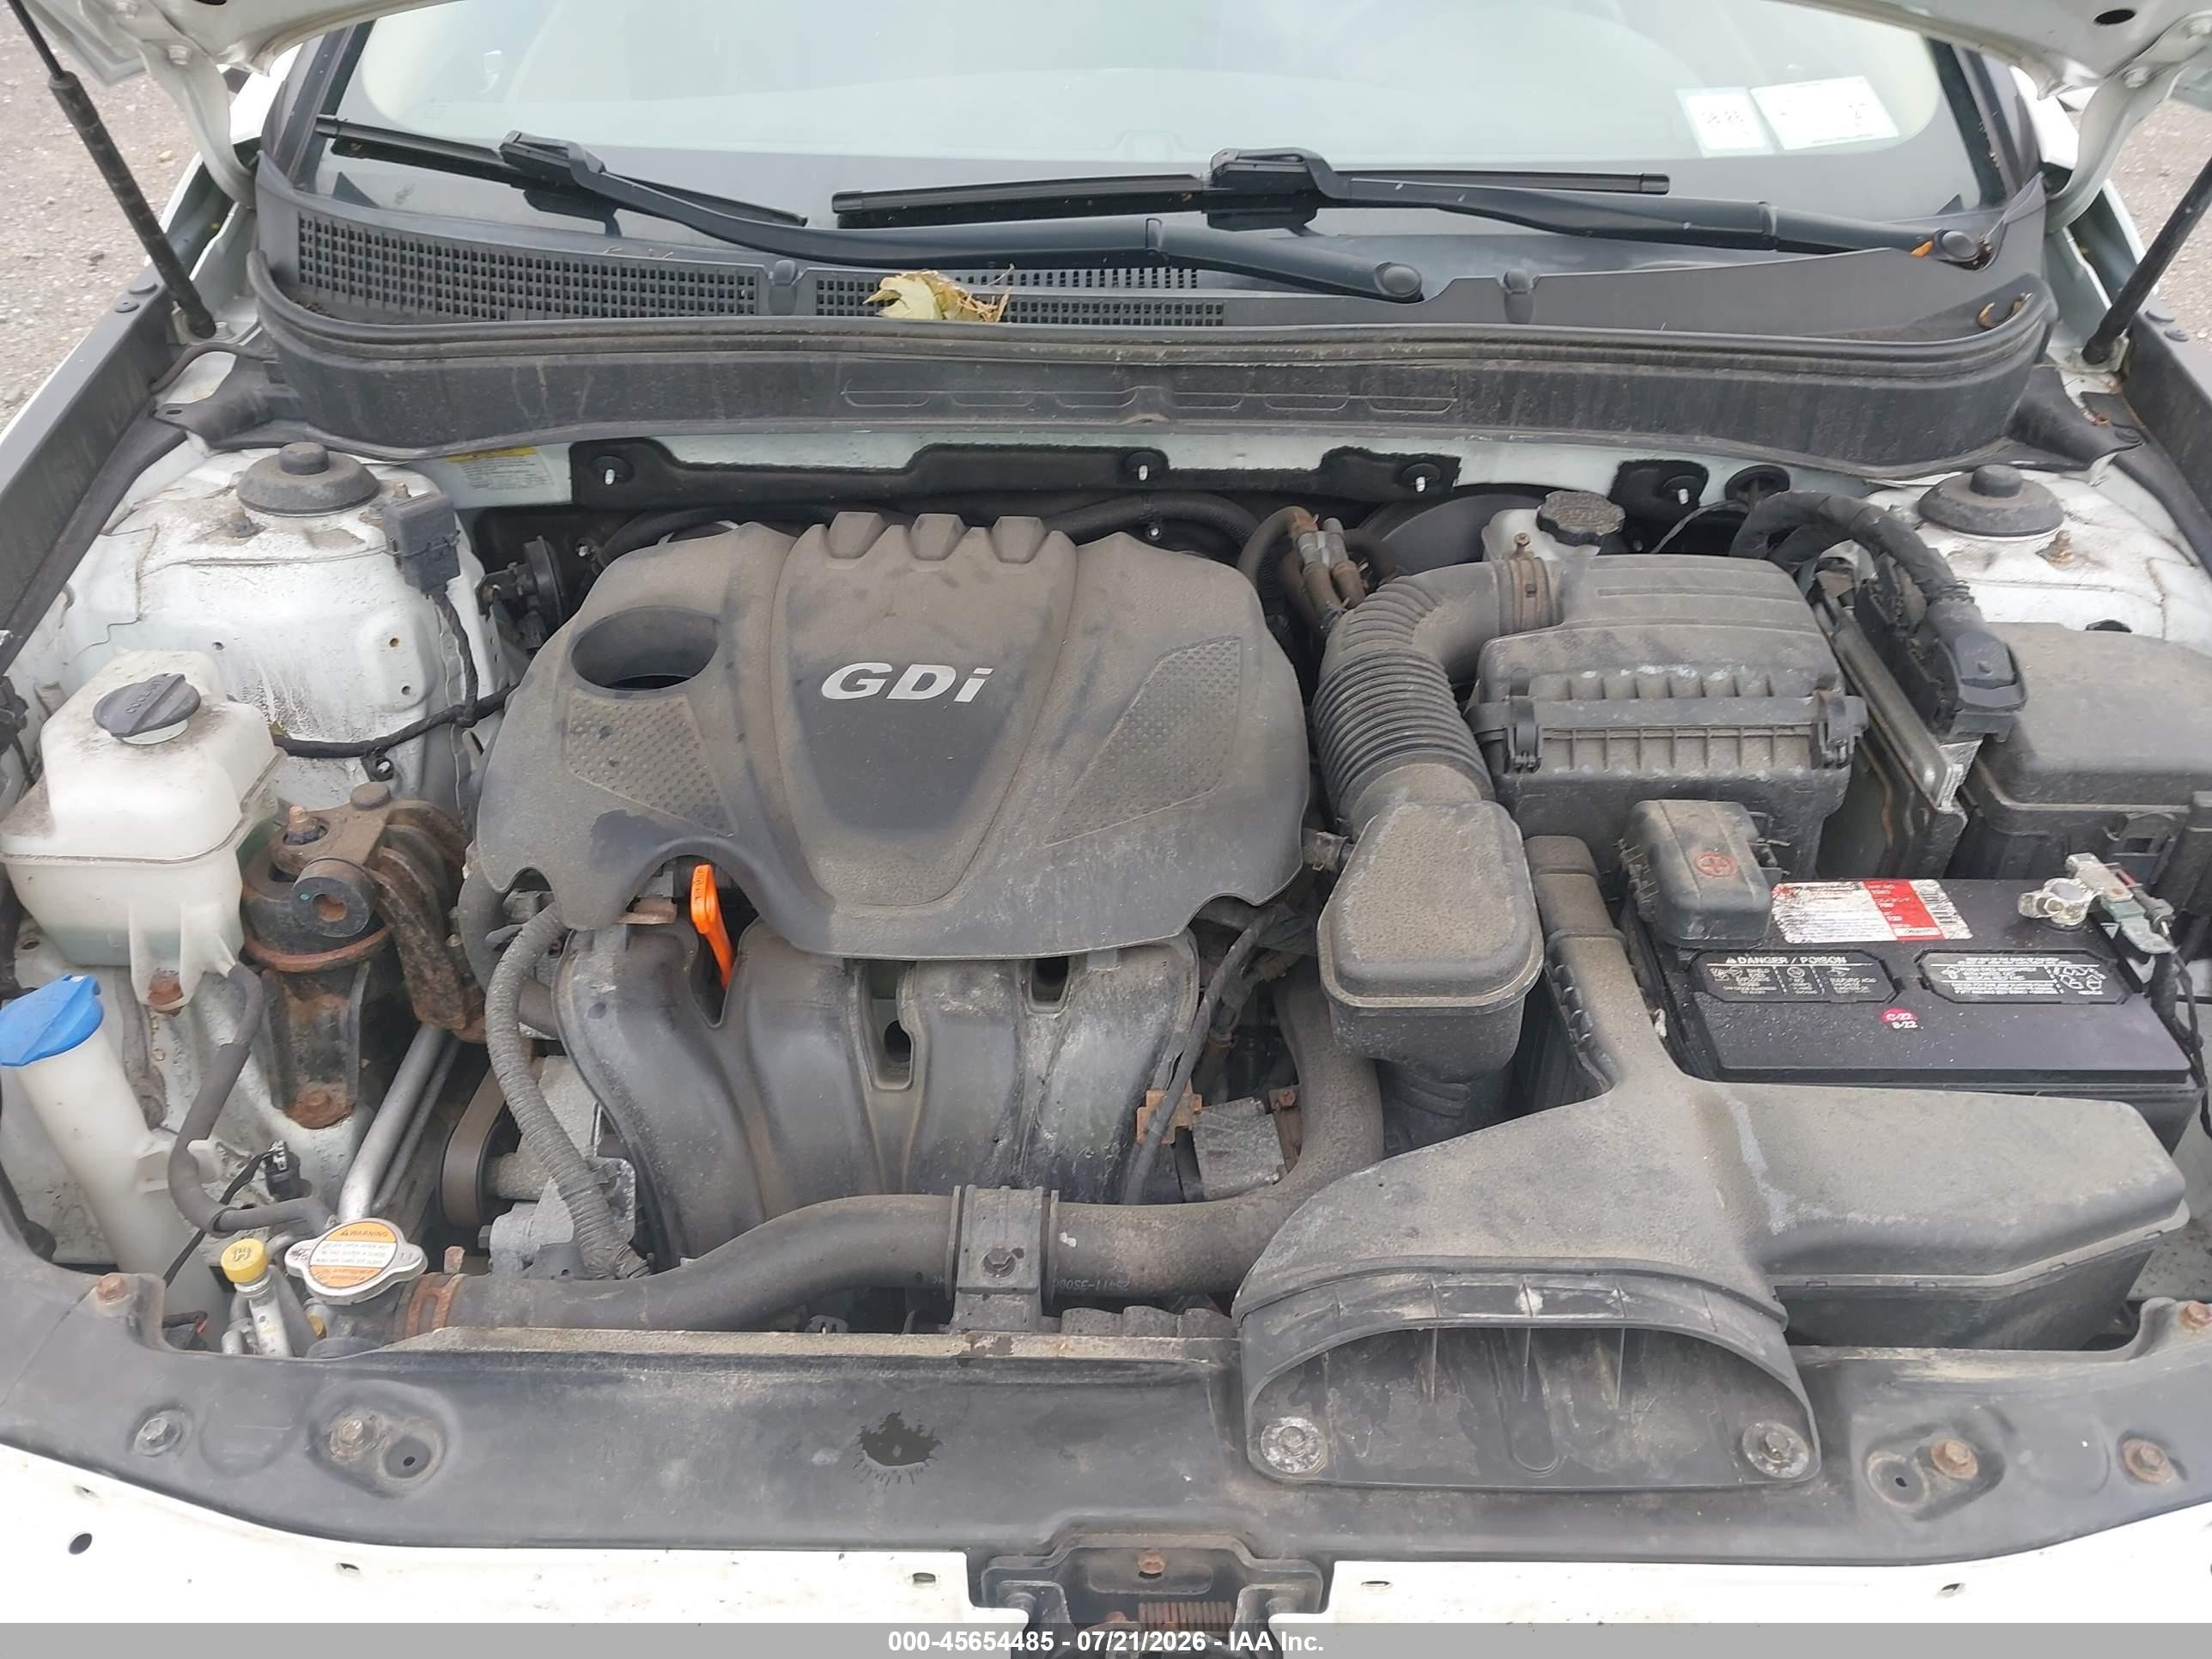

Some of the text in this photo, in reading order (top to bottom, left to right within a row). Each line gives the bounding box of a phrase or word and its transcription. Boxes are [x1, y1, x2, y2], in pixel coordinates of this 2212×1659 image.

[820, 662, 994, 703] GDi
[1737, 956, 1789, 965] DANGER
[1800, 956, 1847, 965] POISON
